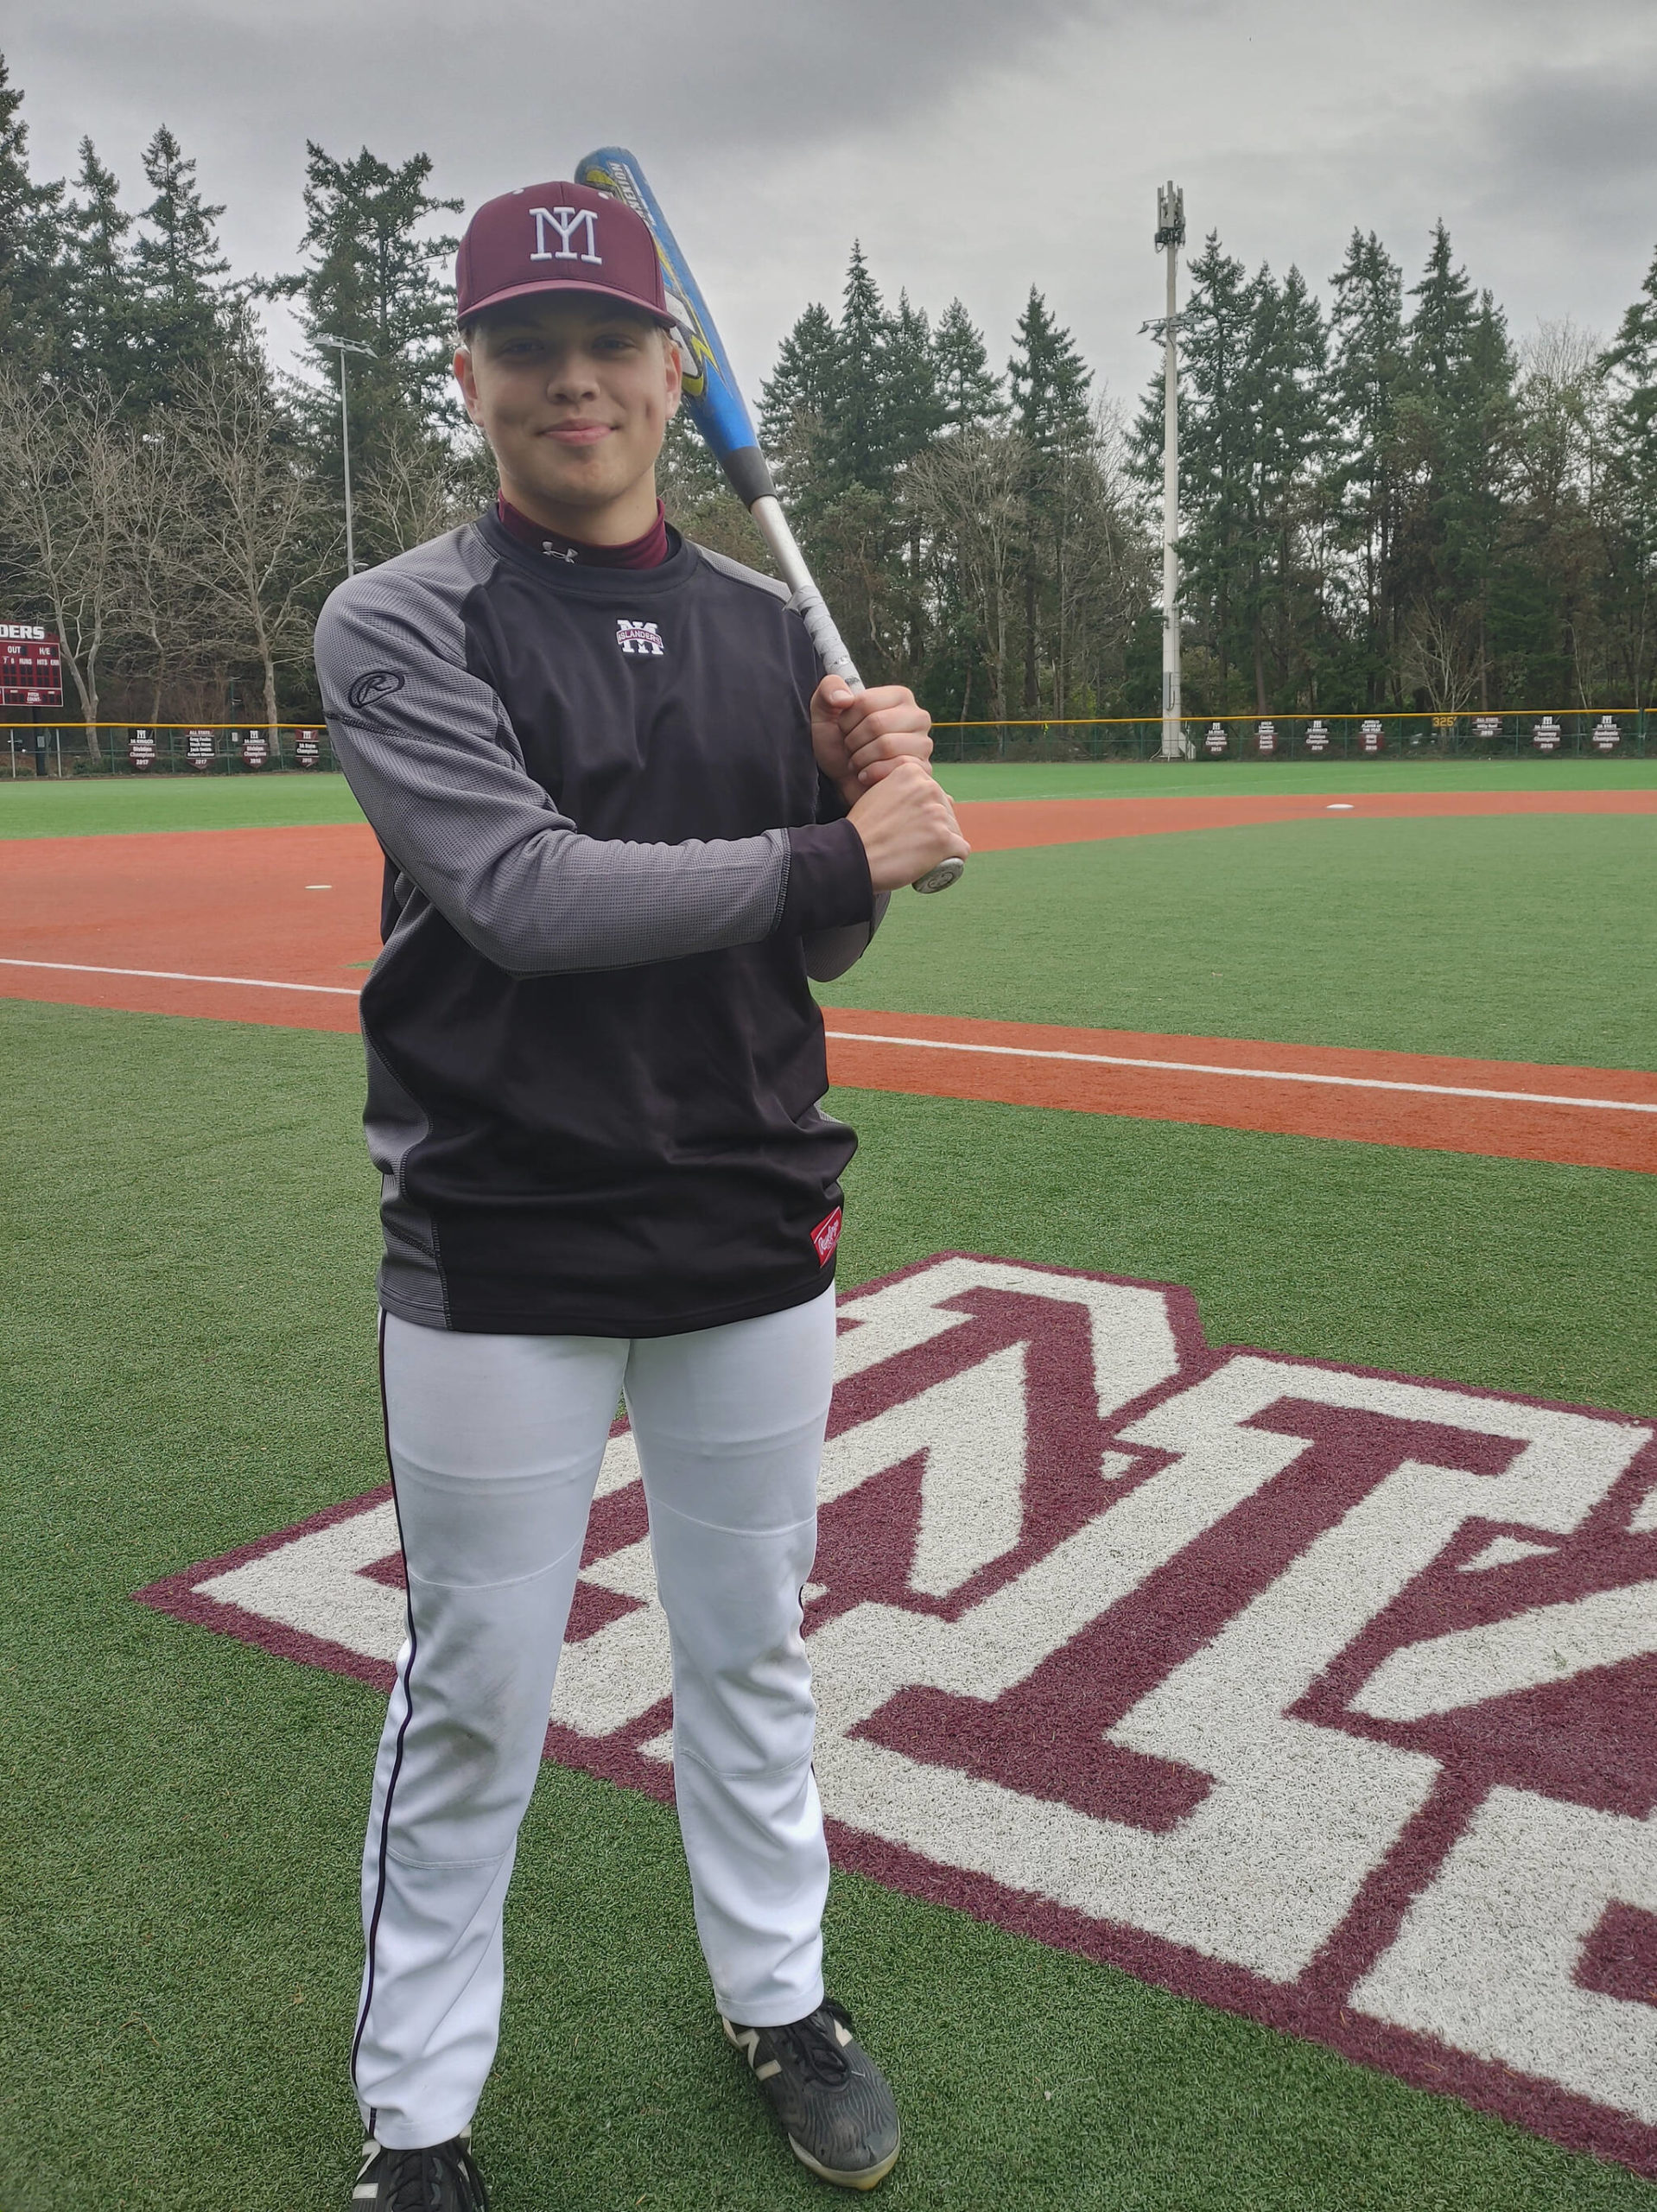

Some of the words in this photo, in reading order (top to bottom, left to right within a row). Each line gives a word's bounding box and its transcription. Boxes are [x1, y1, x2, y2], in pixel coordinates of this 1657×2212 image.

[0, 624, 45, 639] DERS
[618, 630, 663, 646] ISLANDERS
[8, 645, 21, 654] OUT
